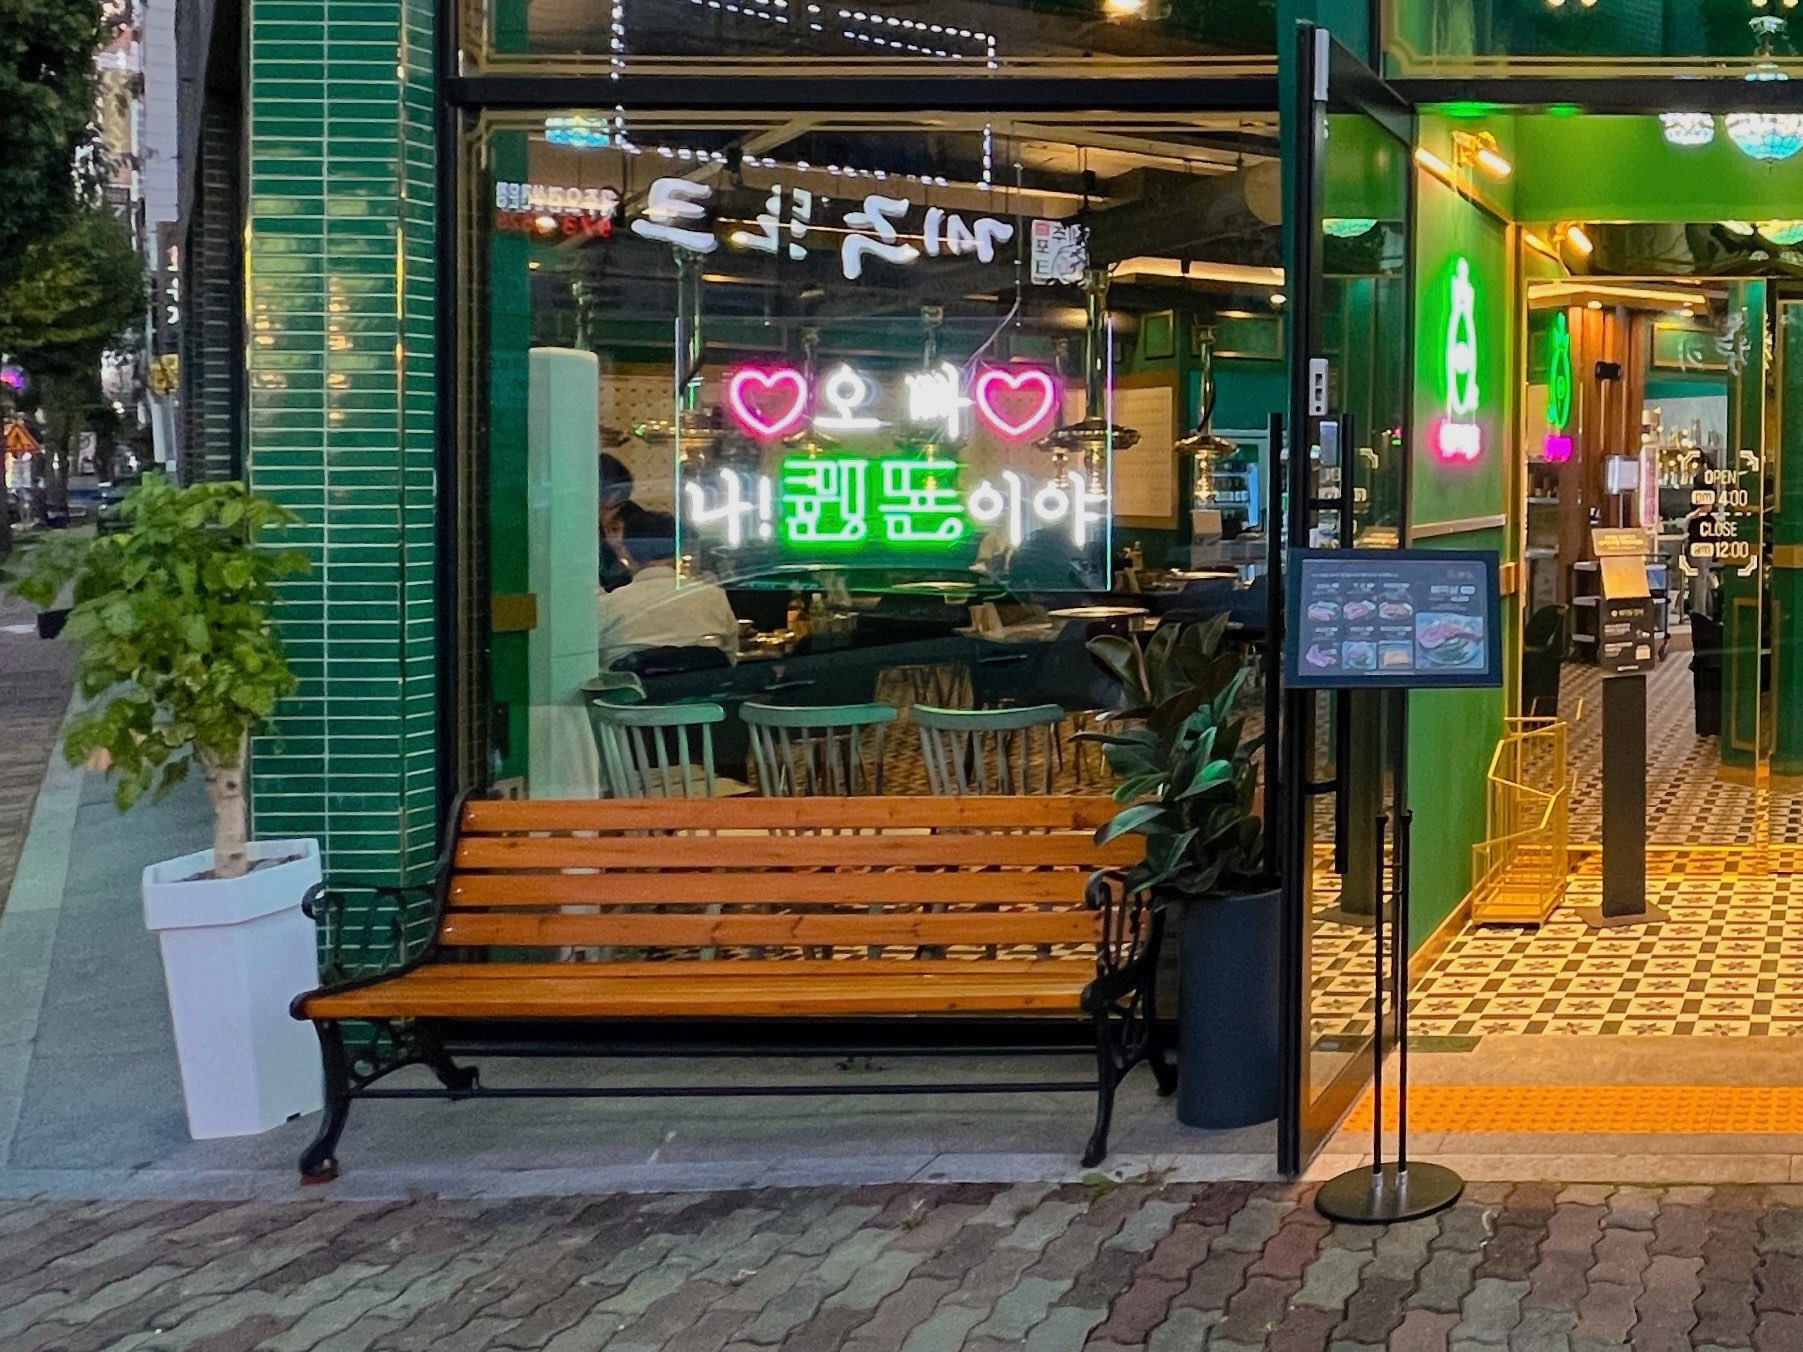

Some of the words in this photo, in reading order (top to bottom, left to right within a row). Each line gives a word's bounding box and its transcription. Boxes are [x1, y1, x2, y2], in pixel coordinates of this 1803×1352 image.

[812, 362, 976, 442] 오빠
[1704, 469, 1737, 485] OPEN
[1718, 489, 1748, 507] 4:00
[1700, 521, 1738, 537] CLOSE
[1715, 541, 1750, 559] 12:00
